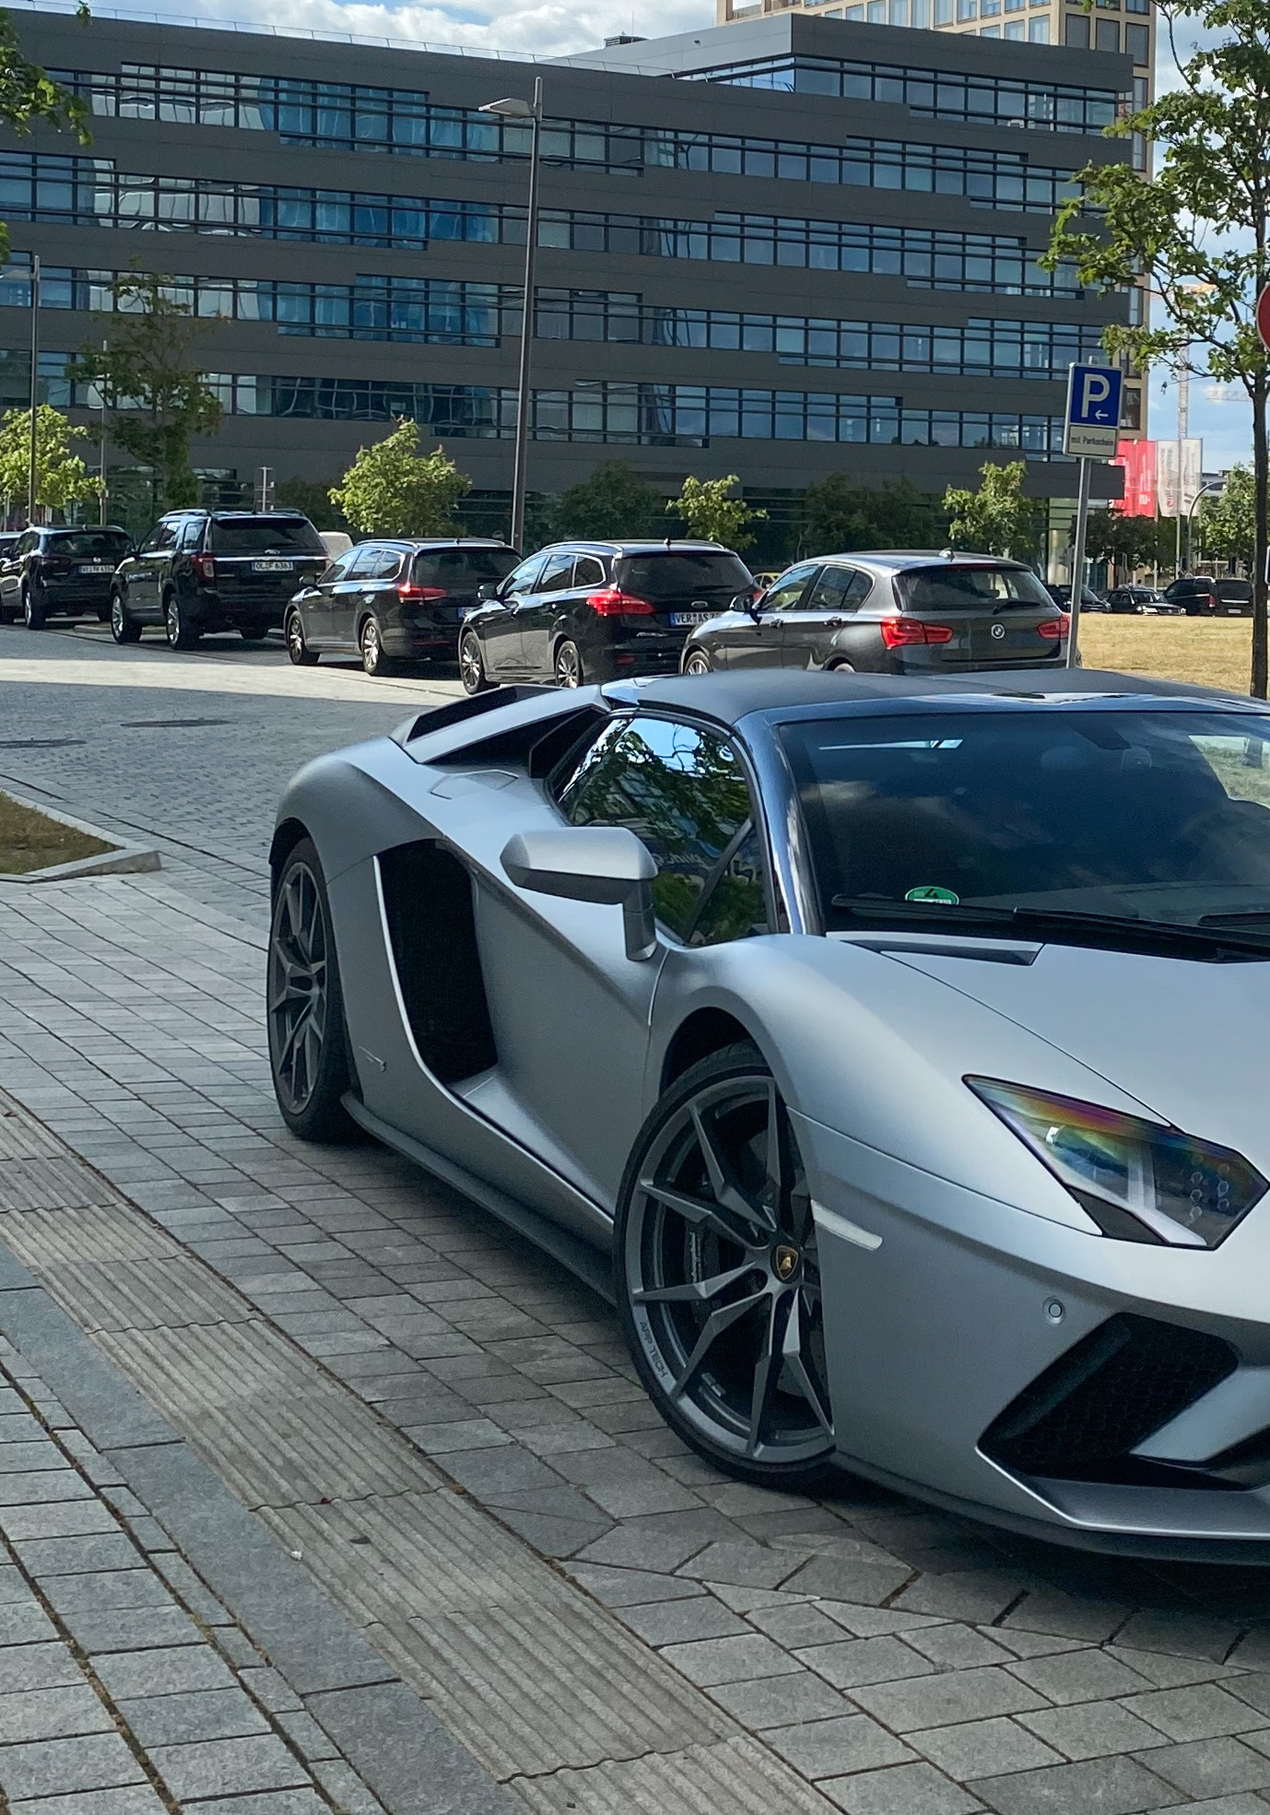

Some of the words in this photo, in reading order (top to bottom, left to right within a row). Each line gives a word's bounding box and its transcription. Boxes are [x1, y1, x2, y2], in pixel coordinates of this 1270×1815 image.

[1081, 373, 1110, 418] P
[675, 613, 692, 623] VER
[649, 1345, 668, 1378] TECH
